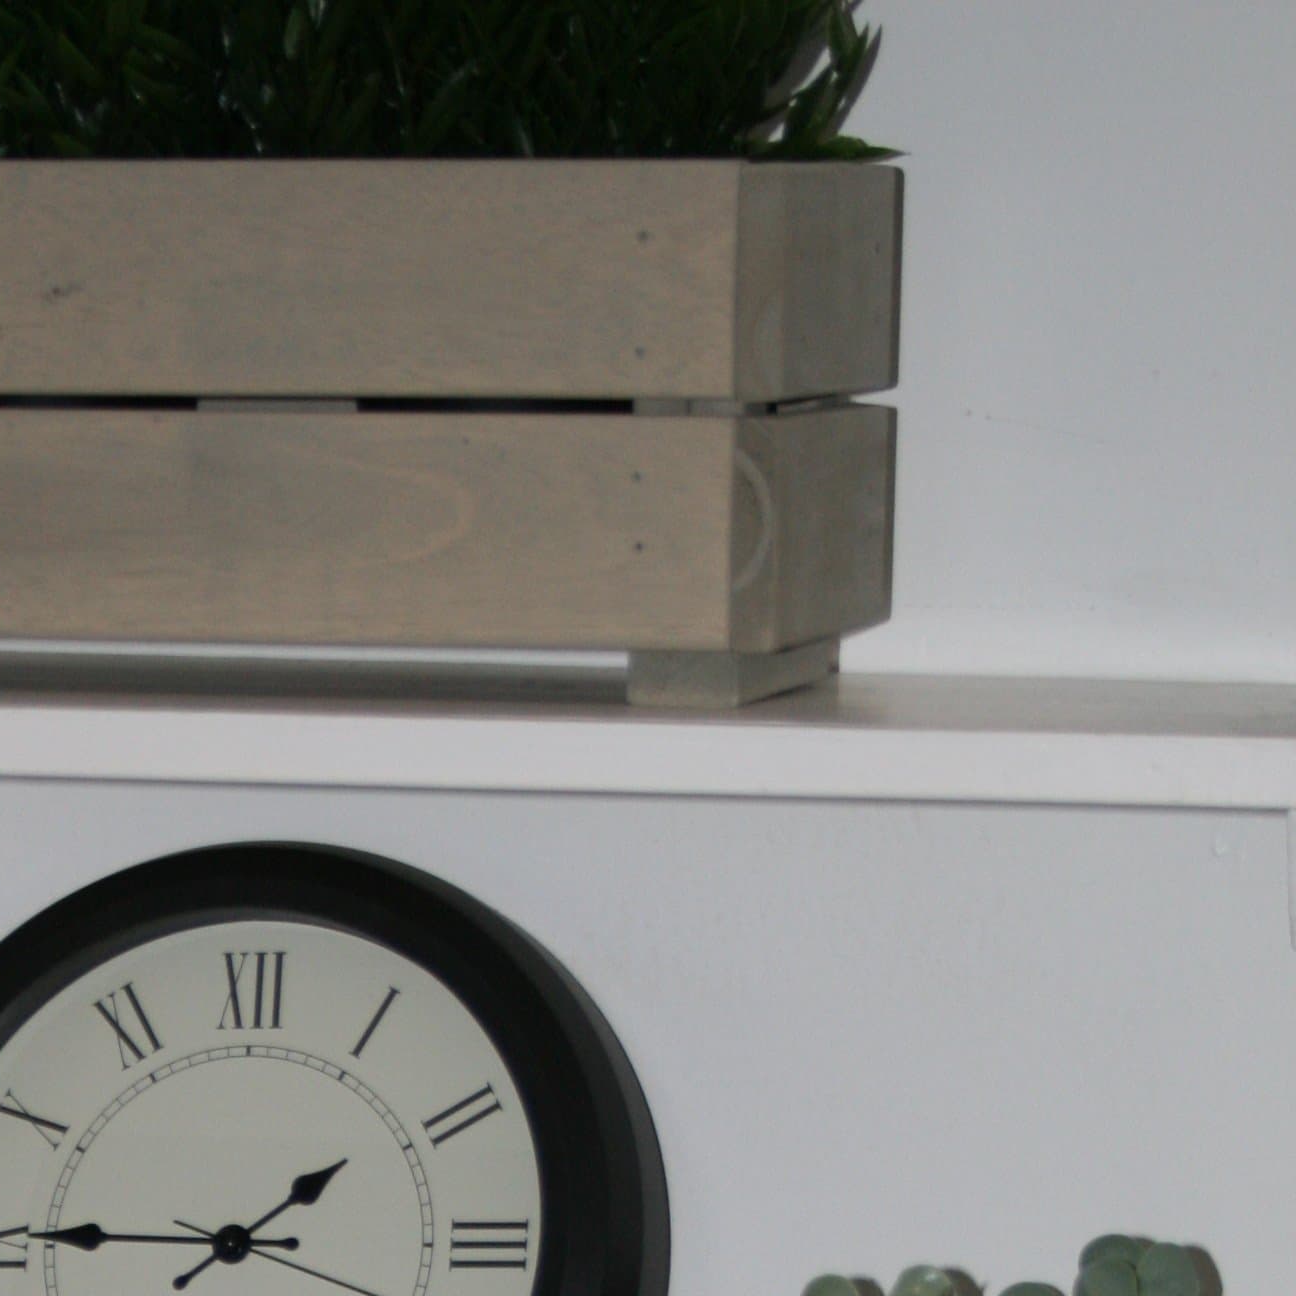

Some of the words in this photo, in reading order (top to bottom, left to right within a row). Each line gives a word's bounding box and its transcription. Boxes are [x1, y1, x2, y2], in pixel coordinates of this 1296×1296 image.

[93, 981, 165, 1070] XI
[216, 950, 287, 1030] XII
[349, 985, 401, 1059] I
[421, 1082, 503, 1148] II
[449, 1218, 529, 1272] III
